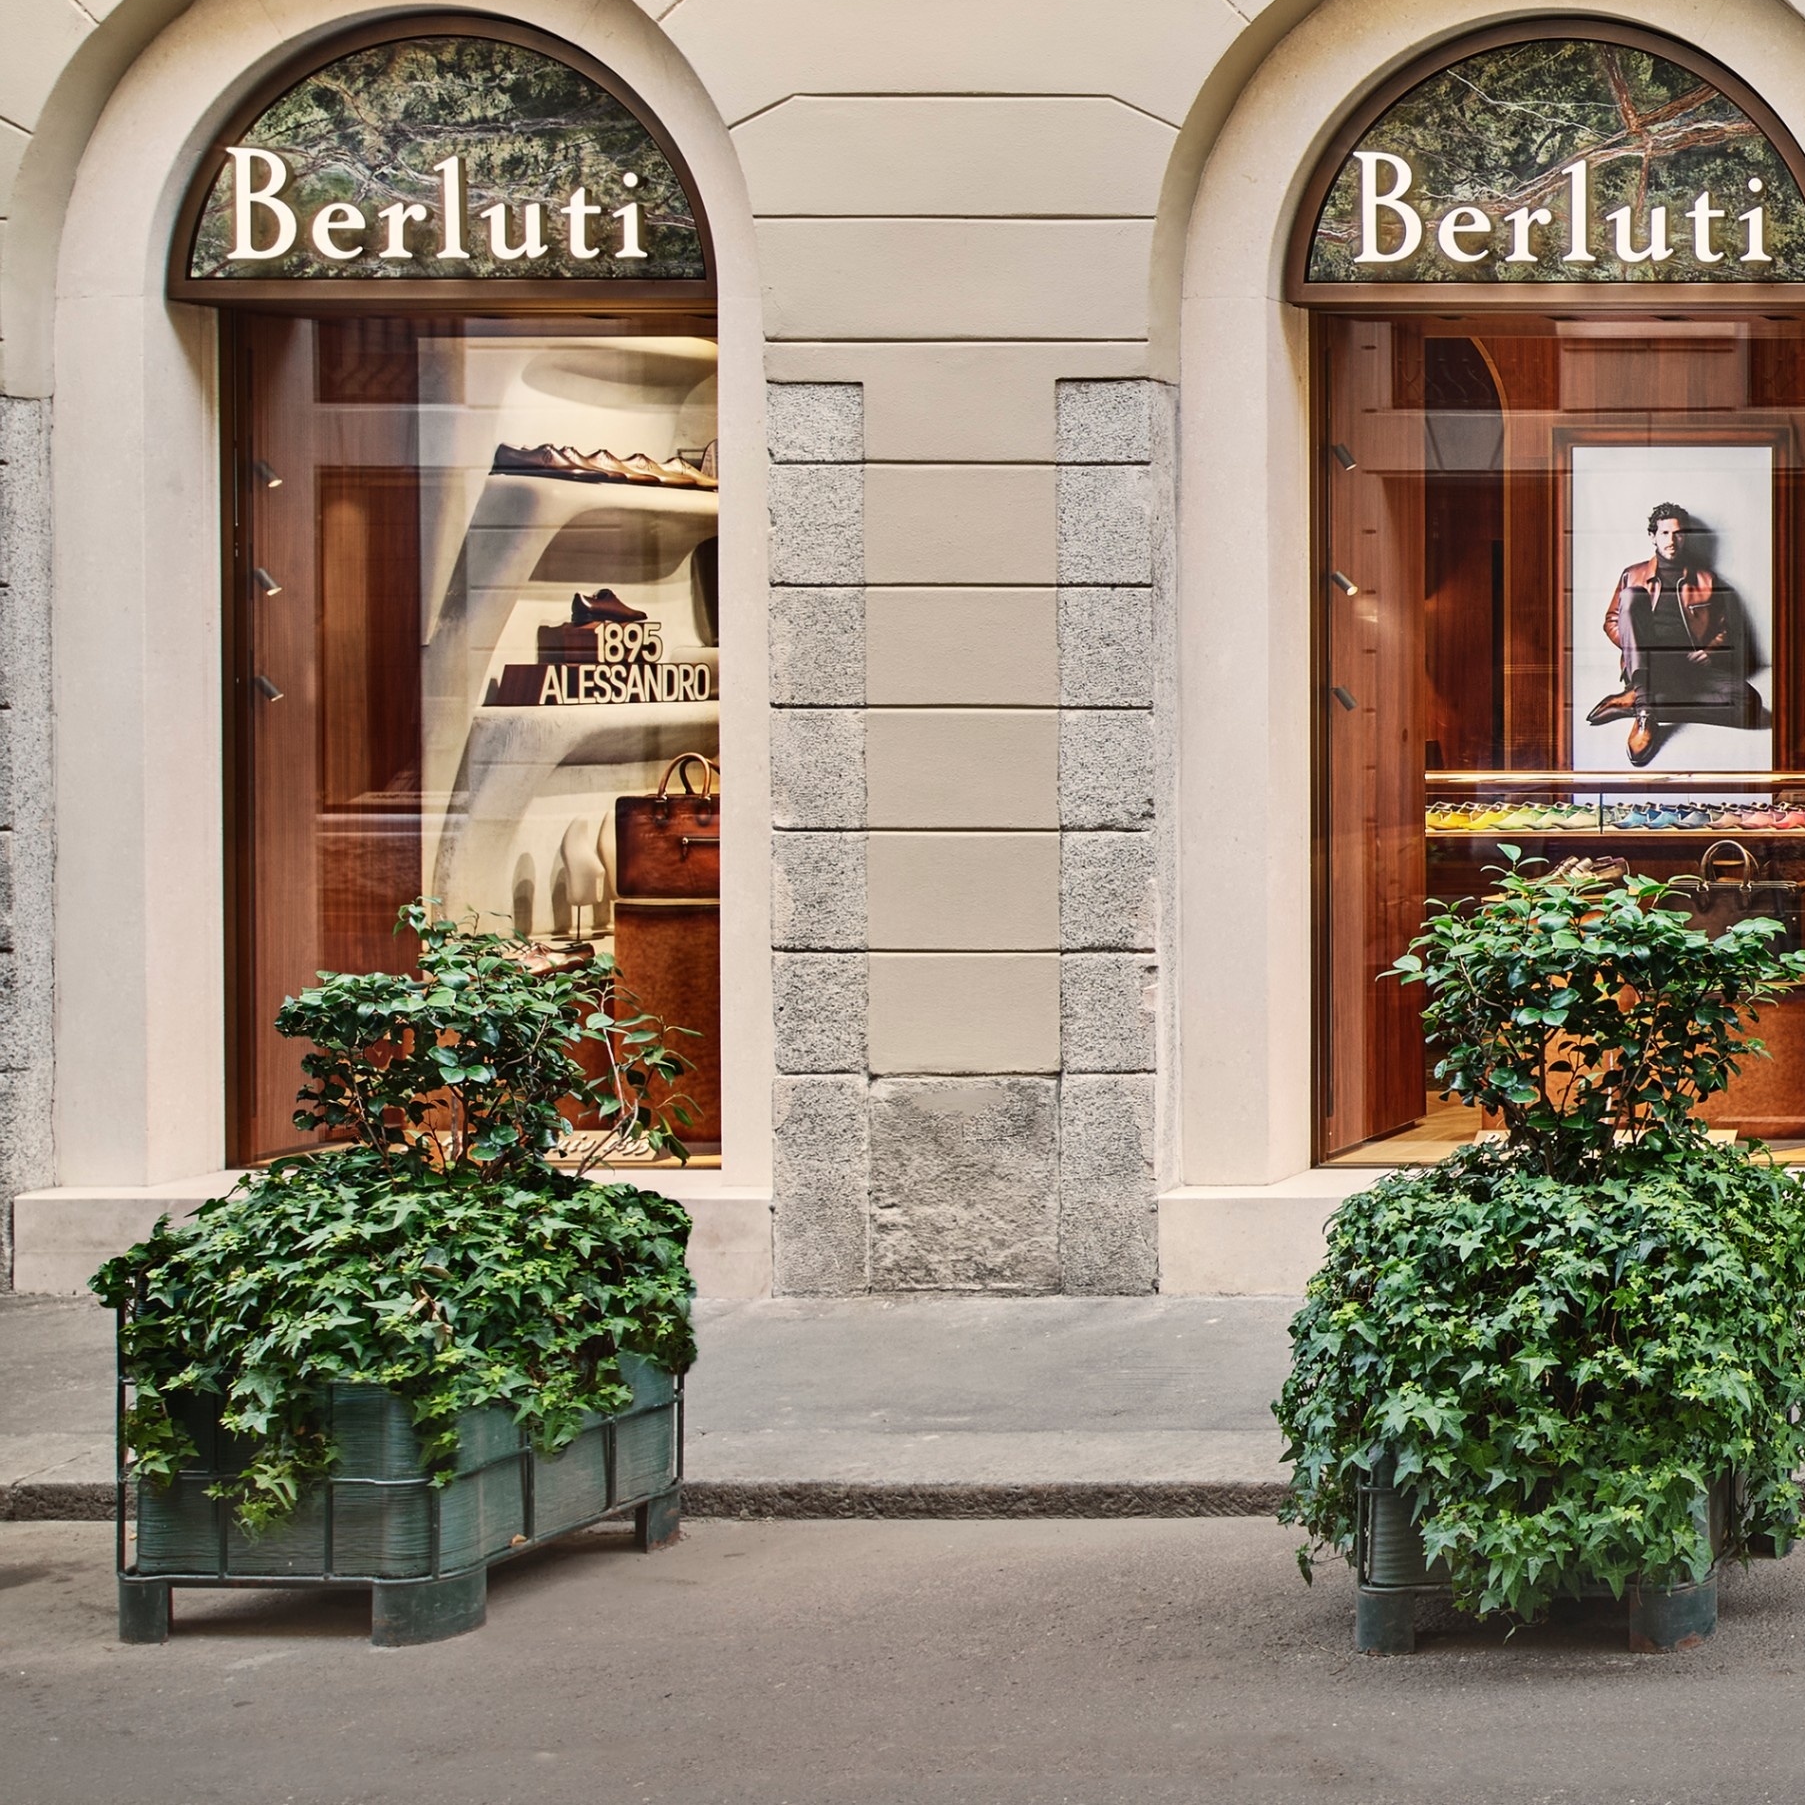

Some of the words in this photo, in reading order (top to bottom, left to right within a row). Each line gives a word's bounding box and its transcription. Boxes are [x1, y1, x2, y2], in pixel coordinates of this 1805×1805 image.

[226, 147, 648, 260] Berluti
[1353, 151, 1772, 263] Berluti
[594, 622, 662, 663] 1895
[539, 663, 711, 705] ALESSANDRO
